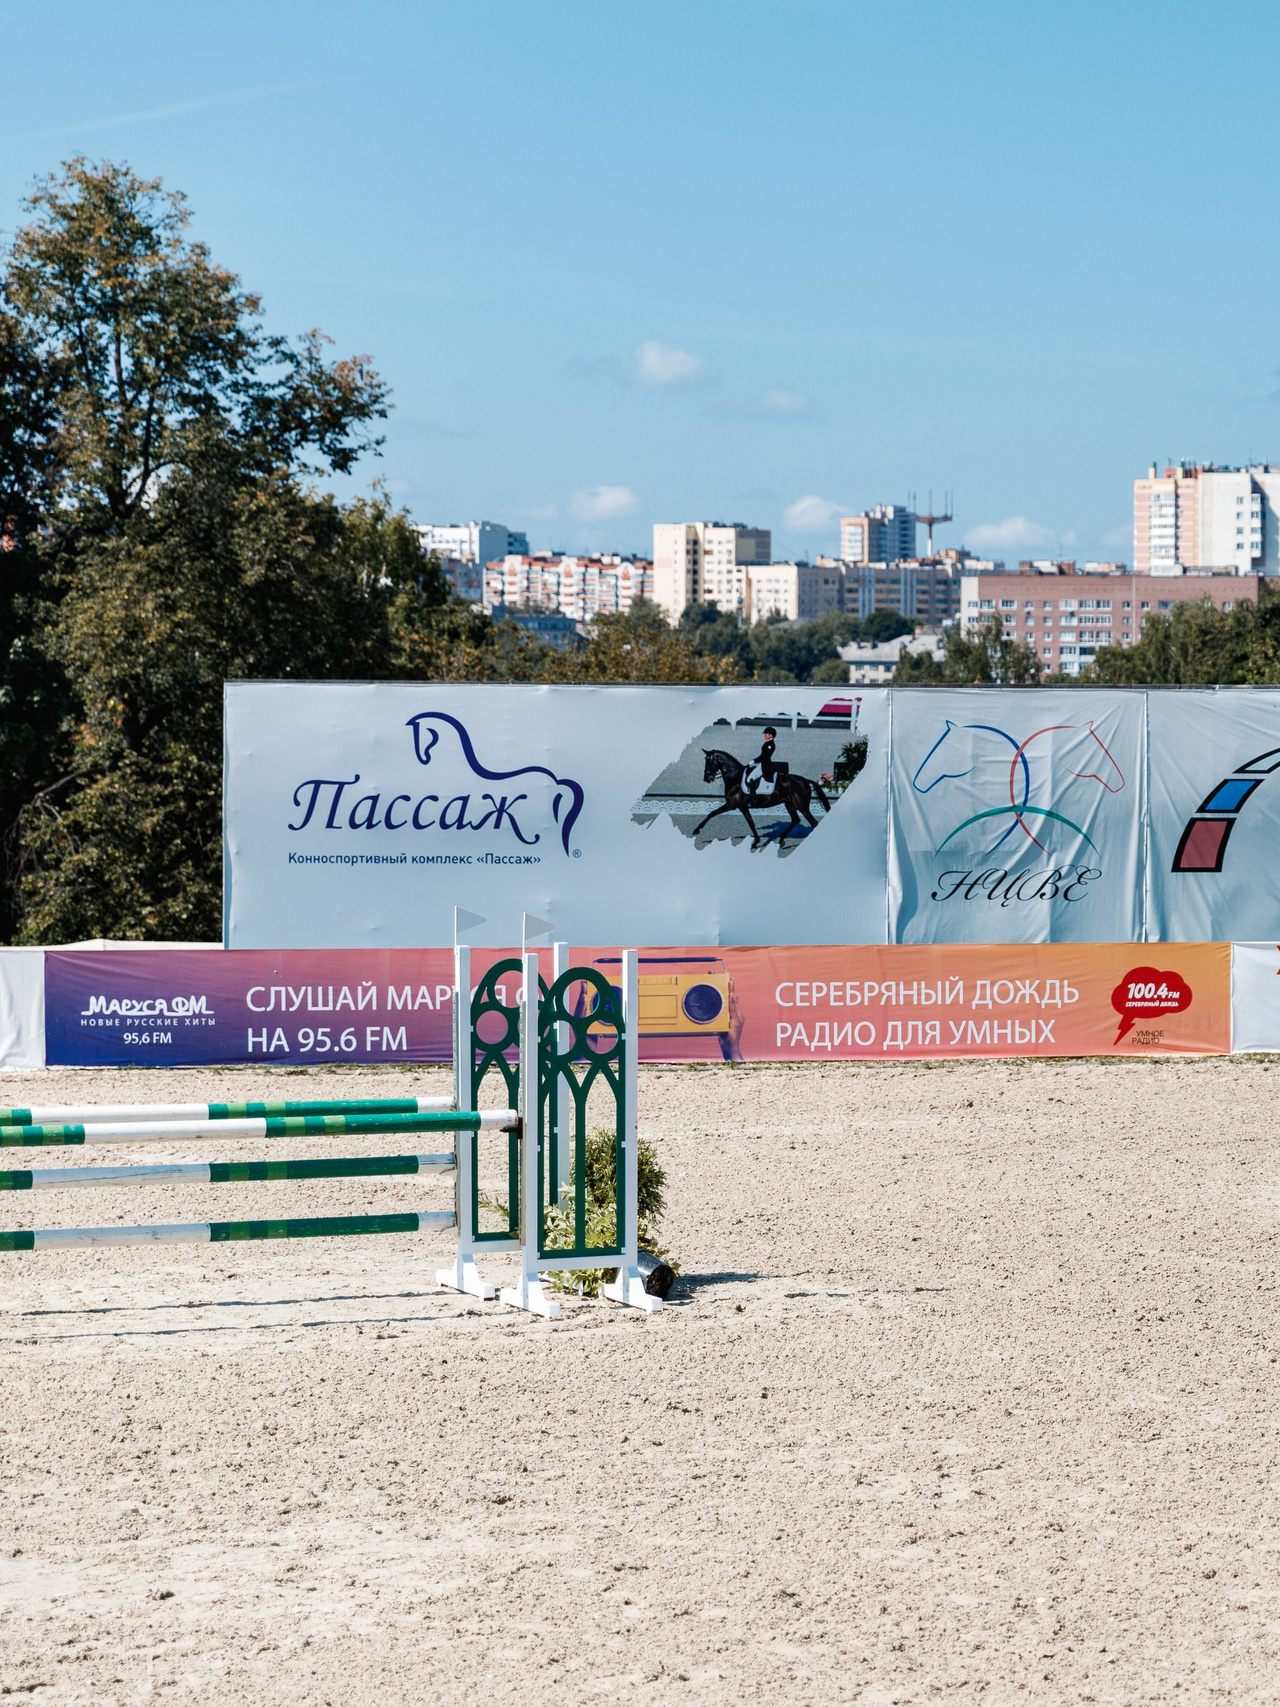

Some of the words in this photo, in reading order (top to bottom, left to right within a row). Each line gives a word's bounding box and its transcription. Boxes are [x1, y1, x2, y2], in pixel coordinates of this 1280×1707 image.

[288, 774, 541, 845] Пассаж
[288, 852, 407, 866] Конноспортивный
[411, 855, 473, 865] комплекс
[477, 853, 541, 865] «Пассаж»
[246, 981, 378, 1012] СЛУШАЙ
[775, 976, 964, 1007] СЕРЕБРЯНЫЙ
[971, 979, 1080, 1010] ДОЖДЬ
[81, 995, 168, 1017] МАРУСЯ
[81, 1018, 120, 1027] НОВЫЕ
[127, 1018, 179, 1027] РУССКИЕ
[185, 1018, 216, 1027] ХИТЫ
[1135, 1029, 1165, 1038] УМНОЕ
[123, 1032, 151, 1046] 95,6
[153, 1032, 173, 1044] FM
[247, 1027, 291, 1053] НА
[297, 1027, 358, 1053] 95.6
[366, 1026, 409, 1052] FM
[776, 1021, 876, 1051] РАДИО
[883, 1020, 942, 1051] ДЛЯ
[948, 1019, 1057, 1046] УМНЫХ
